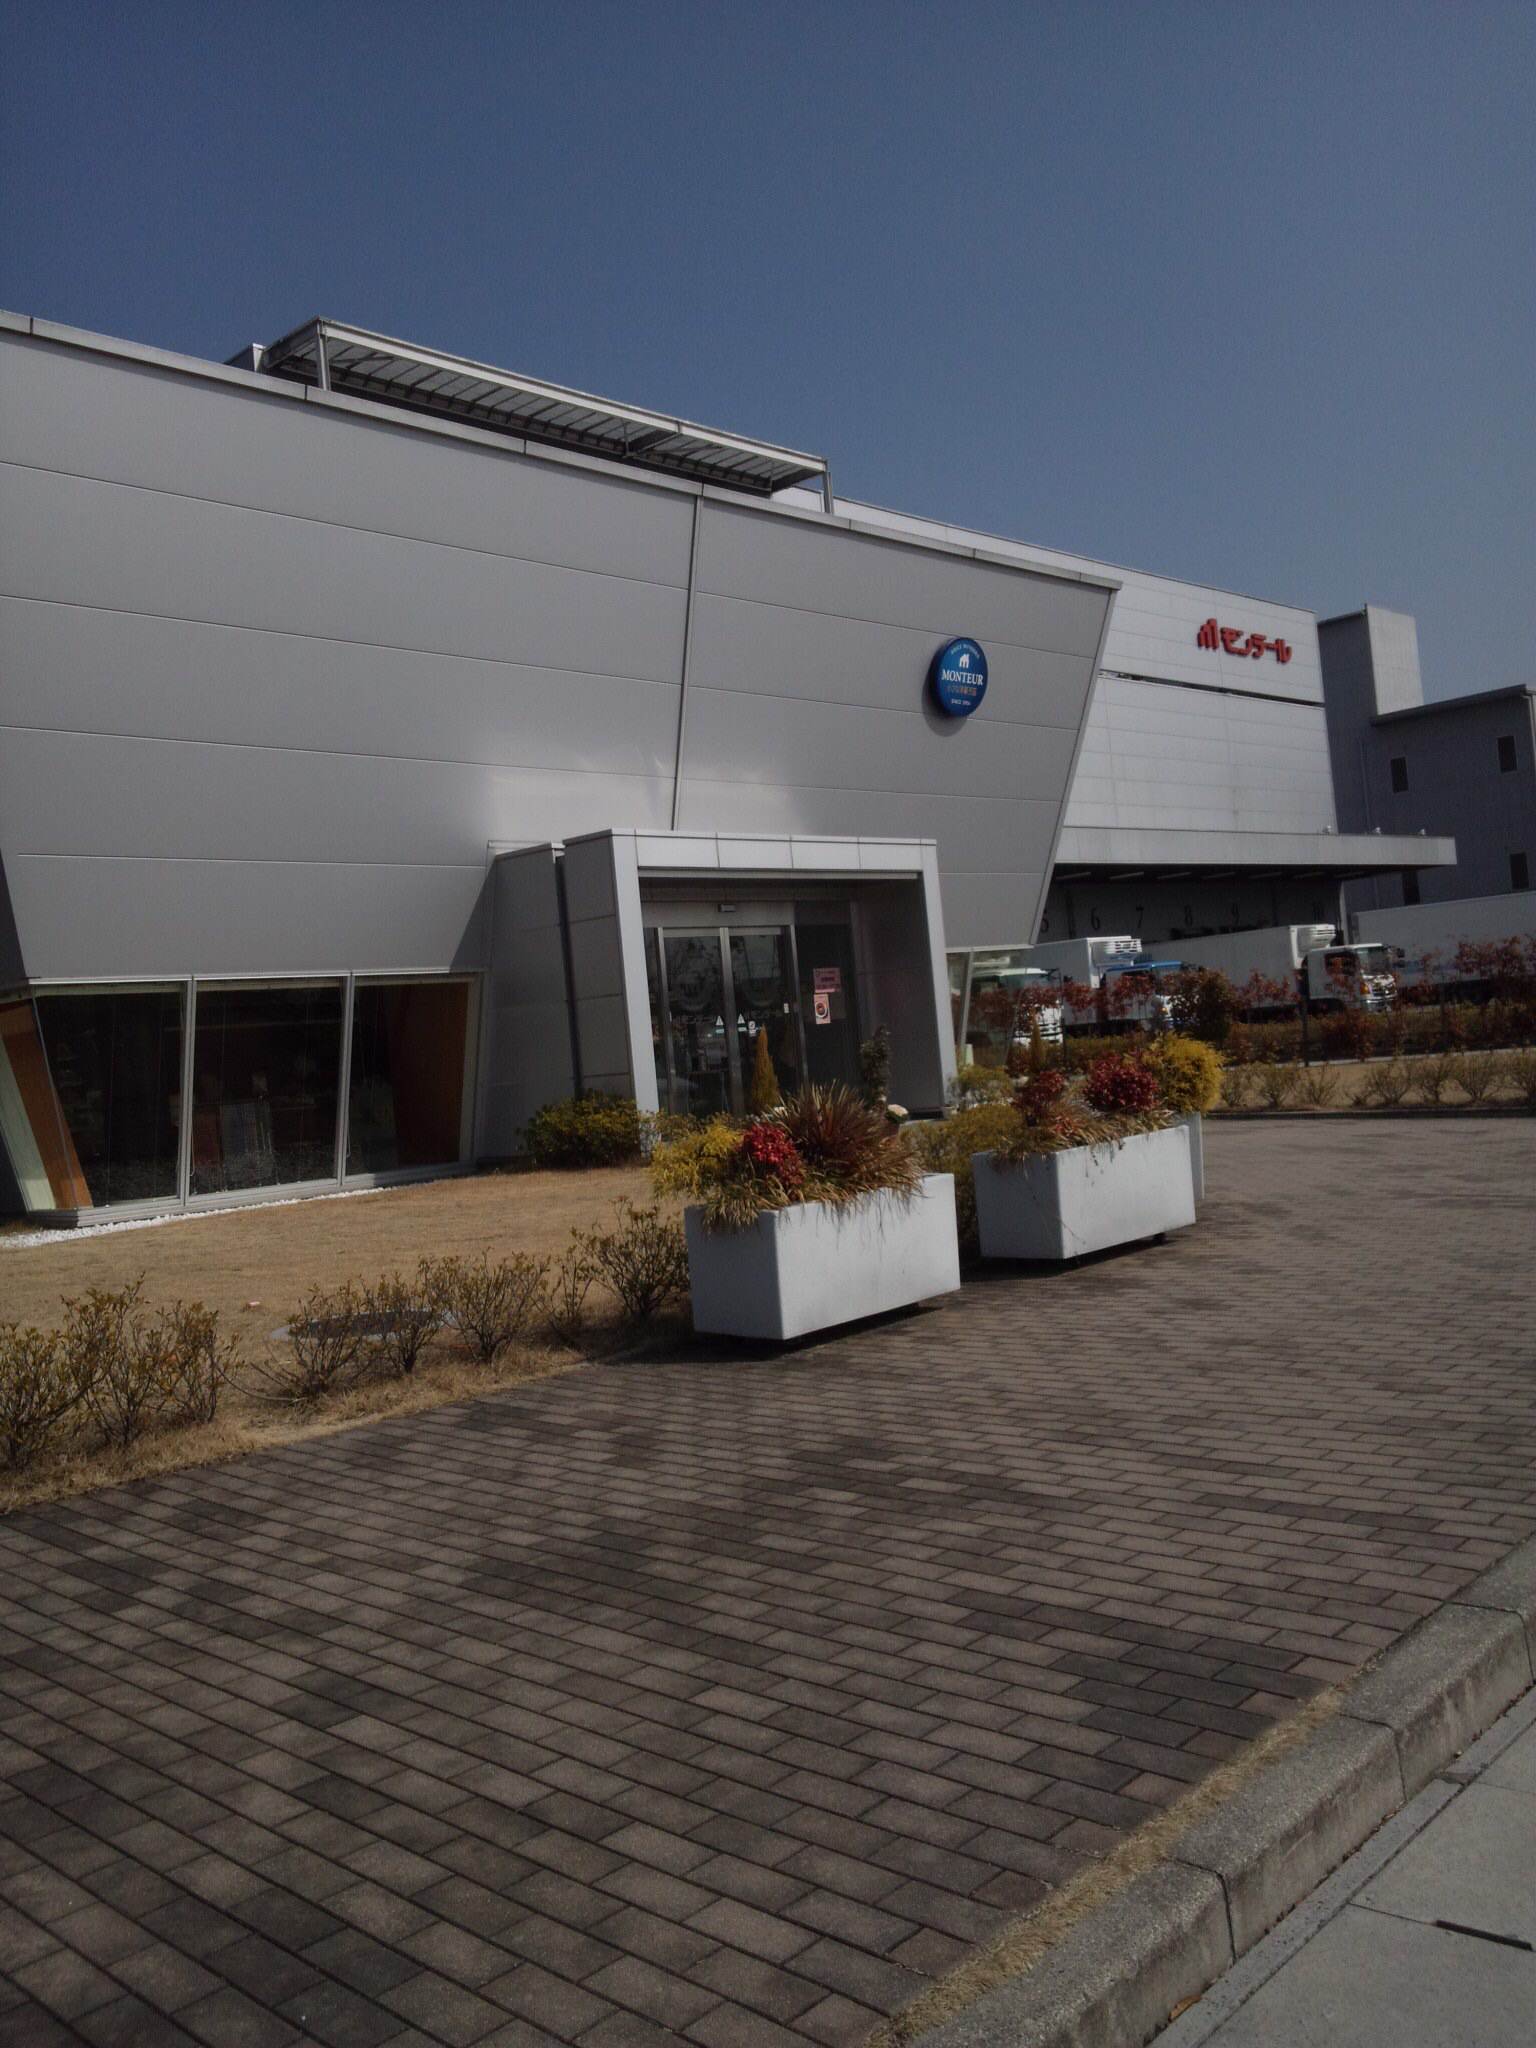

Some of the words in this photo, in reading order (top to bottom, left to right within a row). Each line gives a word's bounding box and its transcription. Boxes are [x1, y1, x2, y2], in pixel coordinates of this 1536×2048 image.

[941, 668, 984, 686] MONTEUR
[1091, 907, 1100, 931] 6
[1136, 906, 1144, 928] 7
